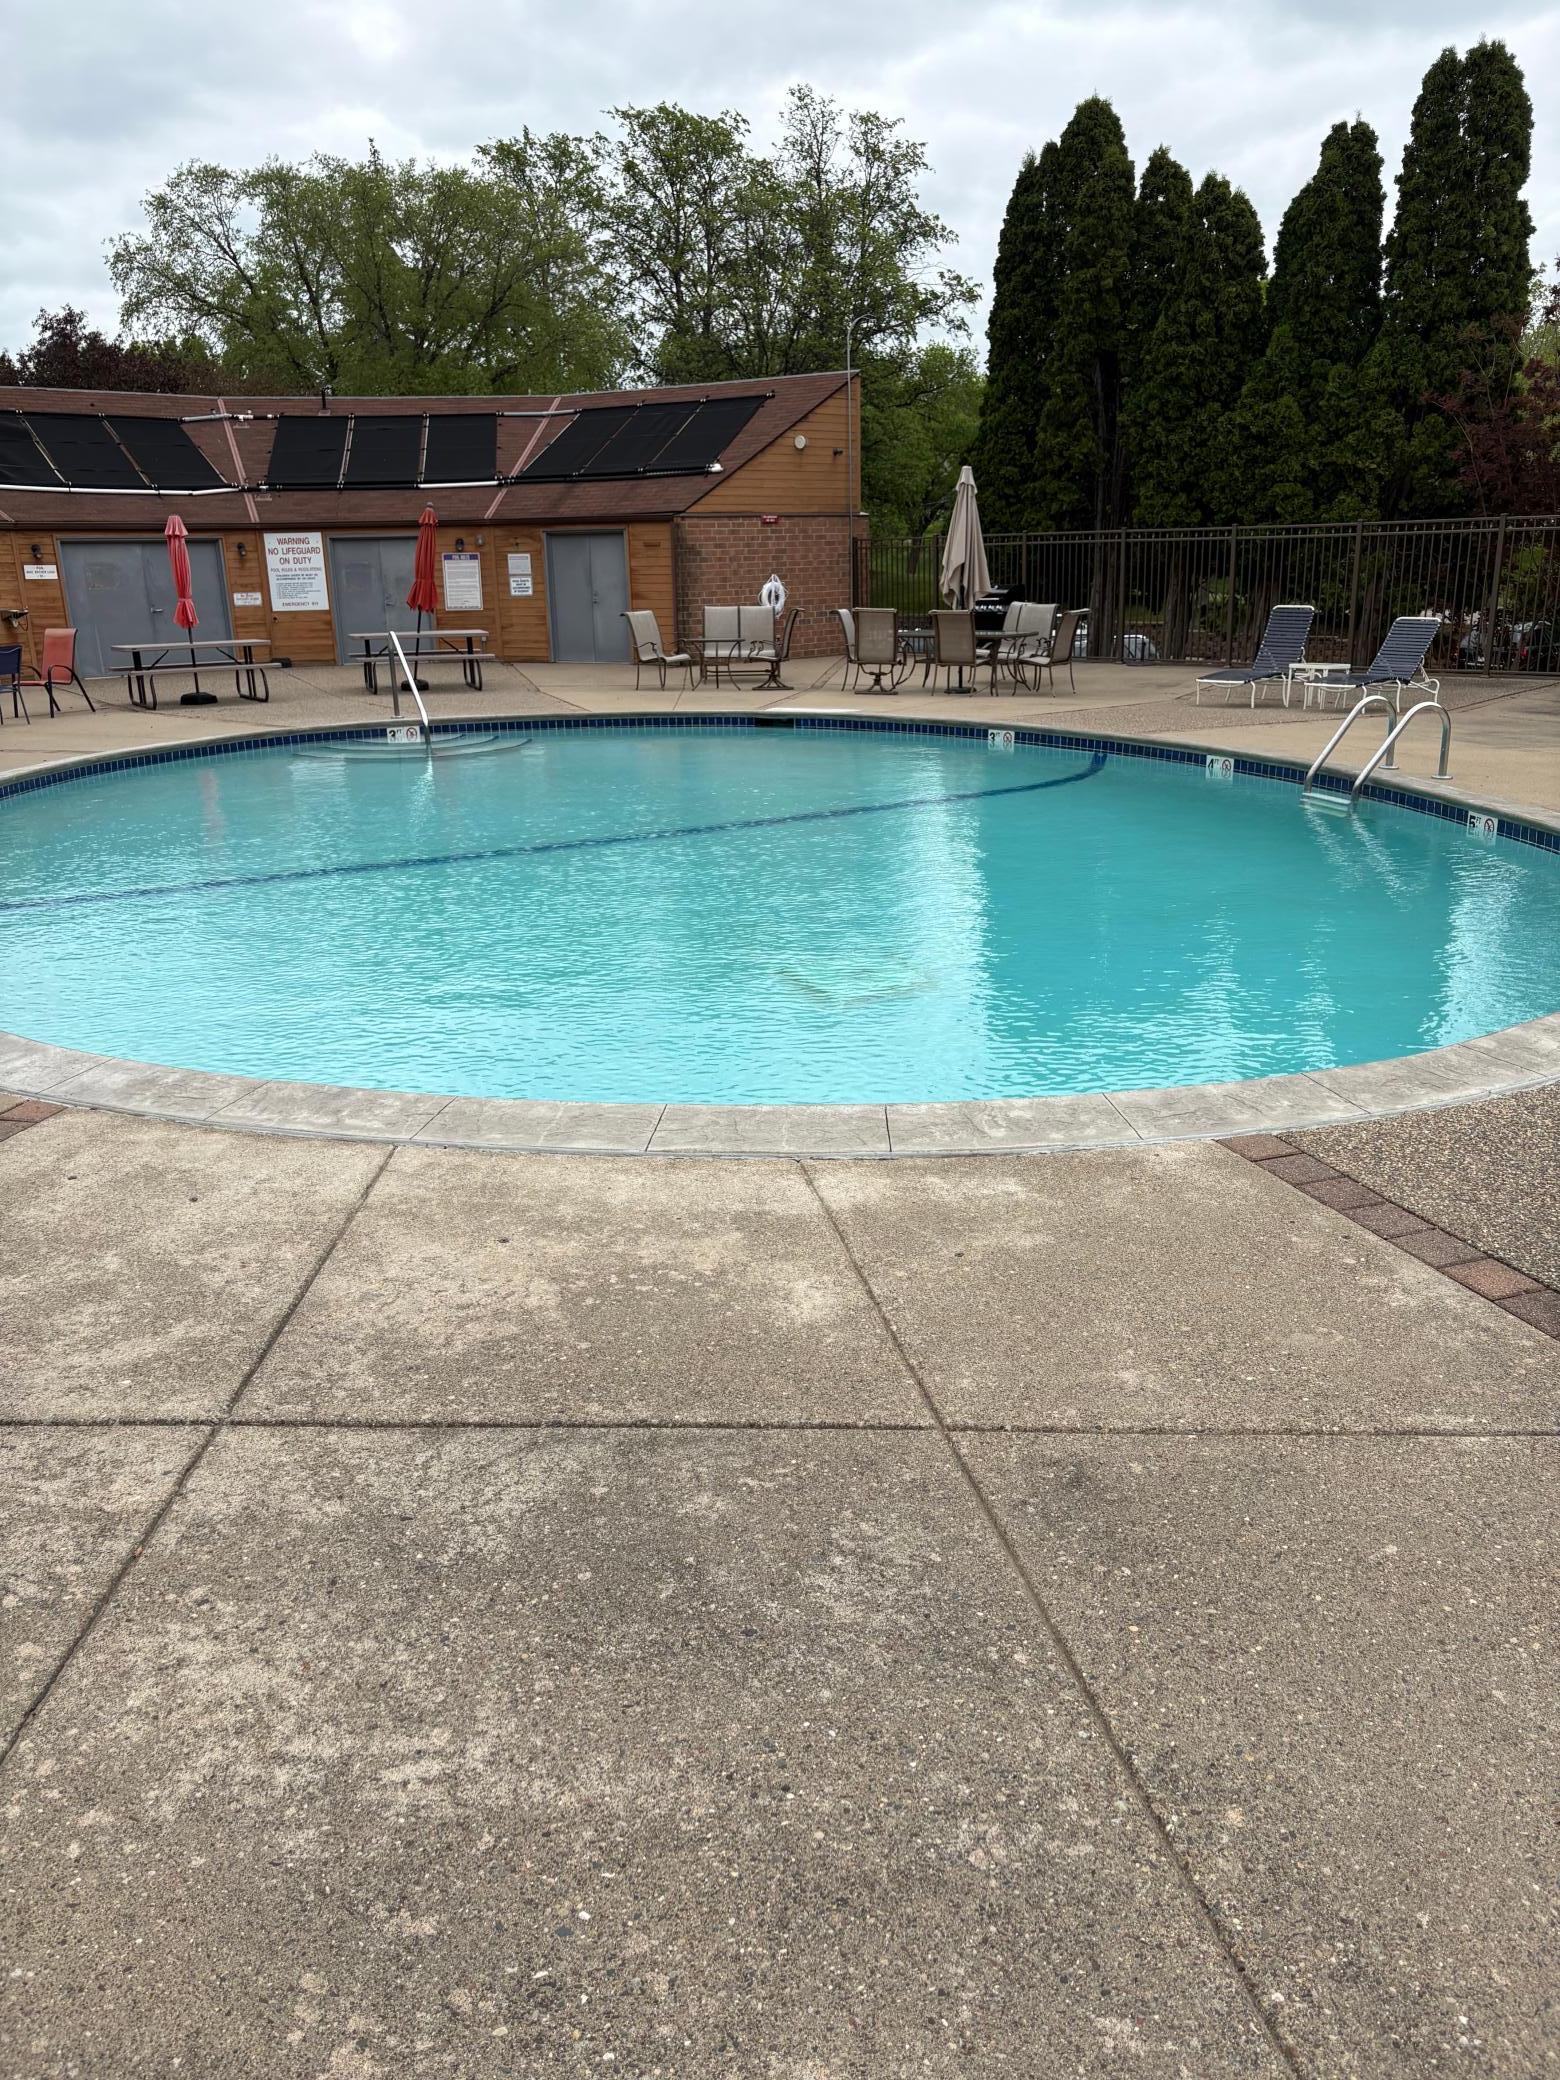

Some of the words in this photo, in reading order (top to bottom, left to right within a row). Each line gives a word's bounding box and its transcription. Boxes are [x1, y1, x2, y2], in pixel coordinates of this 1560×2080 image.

[277, 537, 310, 545] WARNING
[282, 547, 320, 555] LIFEGUARD
[279, 557, 290, 565] ON
[293, 557, 312, 565] DUTY
[1469, 814, 1476, 828] 5
